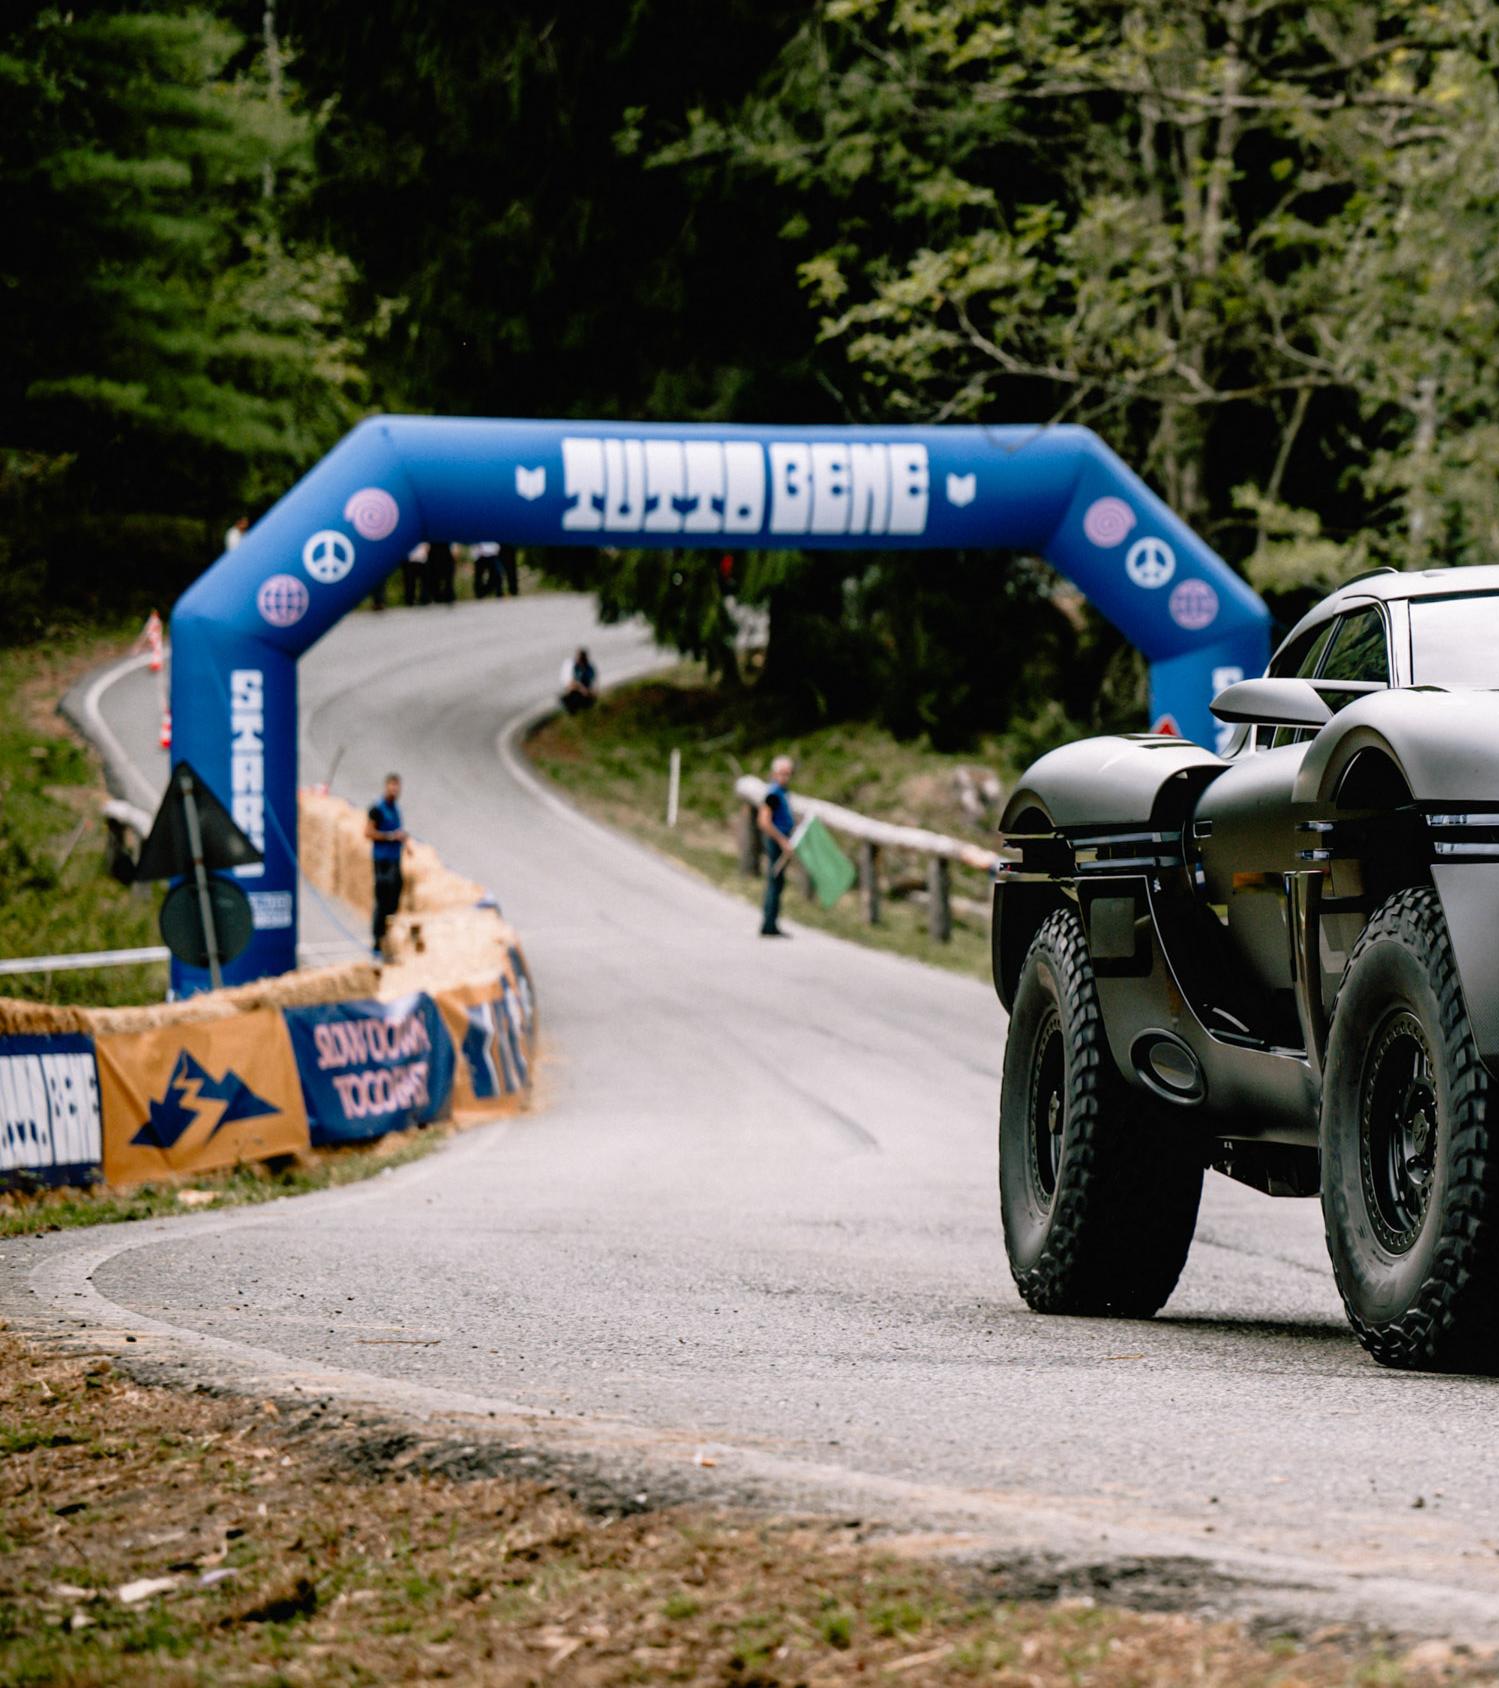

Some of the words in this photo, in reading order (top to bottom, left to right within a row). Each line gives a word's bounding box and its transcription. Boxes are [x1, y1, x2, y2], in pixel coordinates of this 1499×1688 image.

[561, 436, 765, 534] TUTTO
[769, 442, 931, 535] BENE
[40, 1052, 103, 1166] BENE
